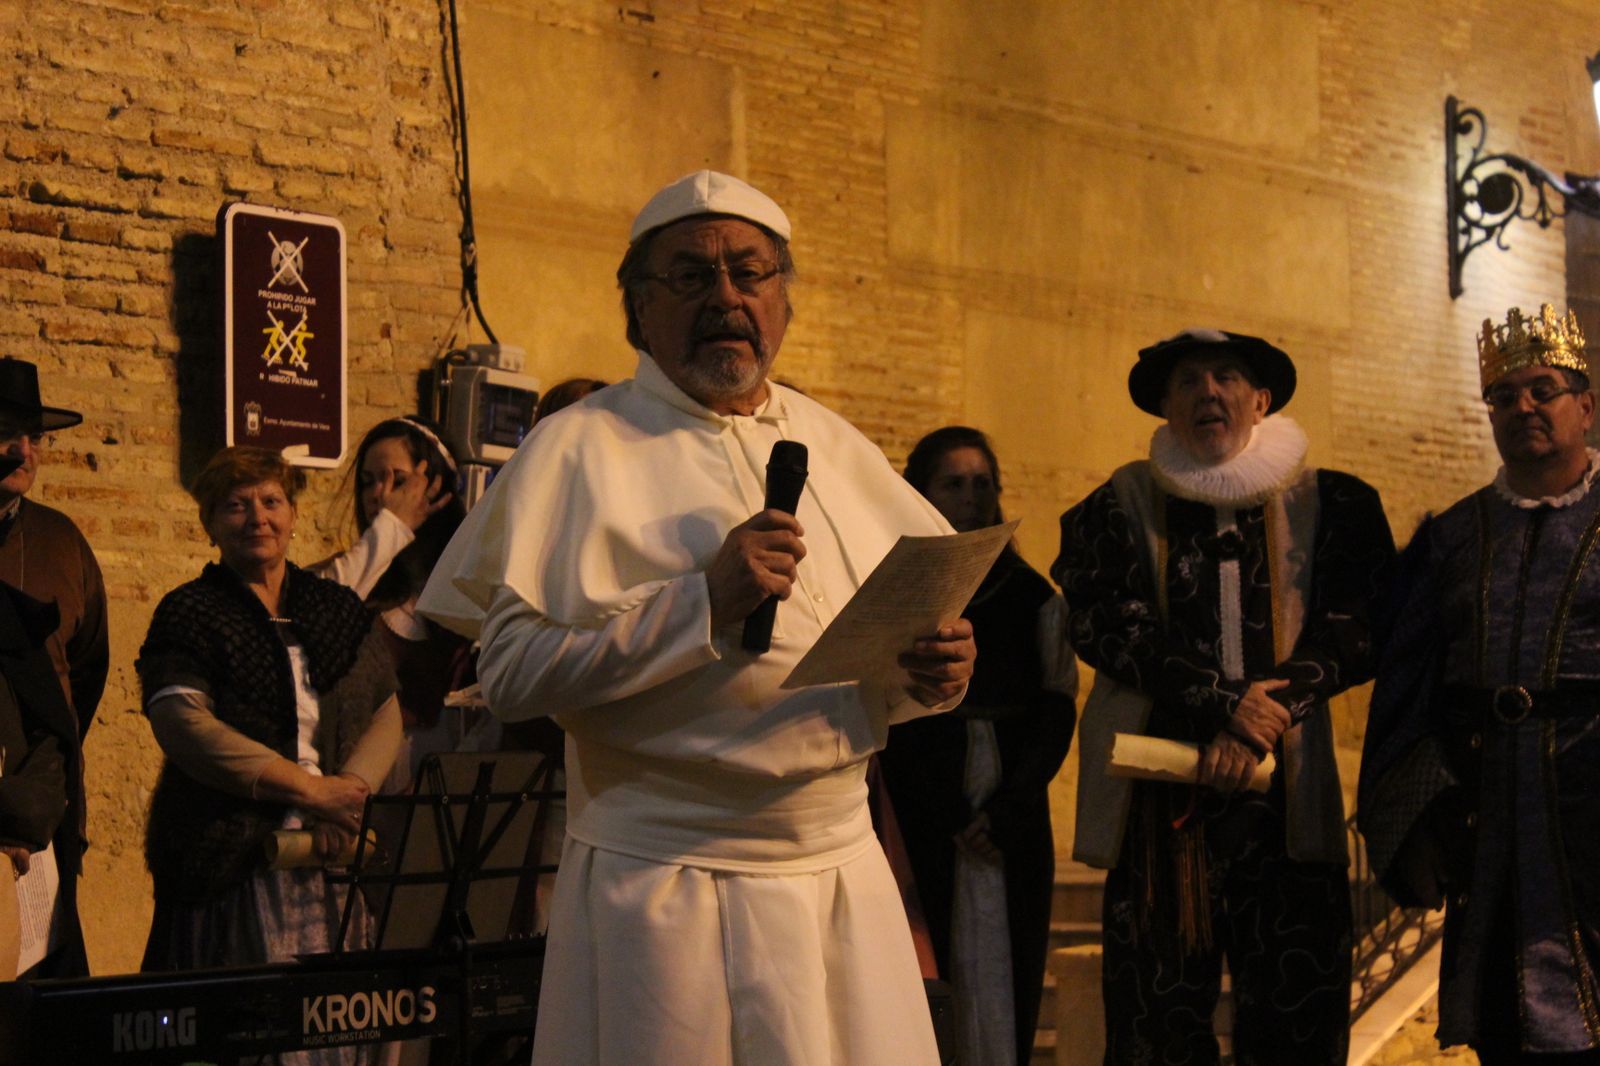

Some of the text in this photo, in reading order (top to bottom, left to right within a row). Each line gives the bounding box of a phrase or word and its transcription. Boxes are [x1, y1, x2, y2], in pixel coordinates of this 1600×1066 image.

[258, 289, 317, 306] PROHIBIDO JUGAR
[266, 300, 272, 308] A
[272, 301, 281, 310] LA
[291, 376, 318, 388] PATINAR
[302, 985, 438, 1035] KRONOS
[112, 1007, 198, 1054] KORG
[302, 1034, 326, 1047] MUSIC
[327, 1030, 381, 1044] WORKSTATION
